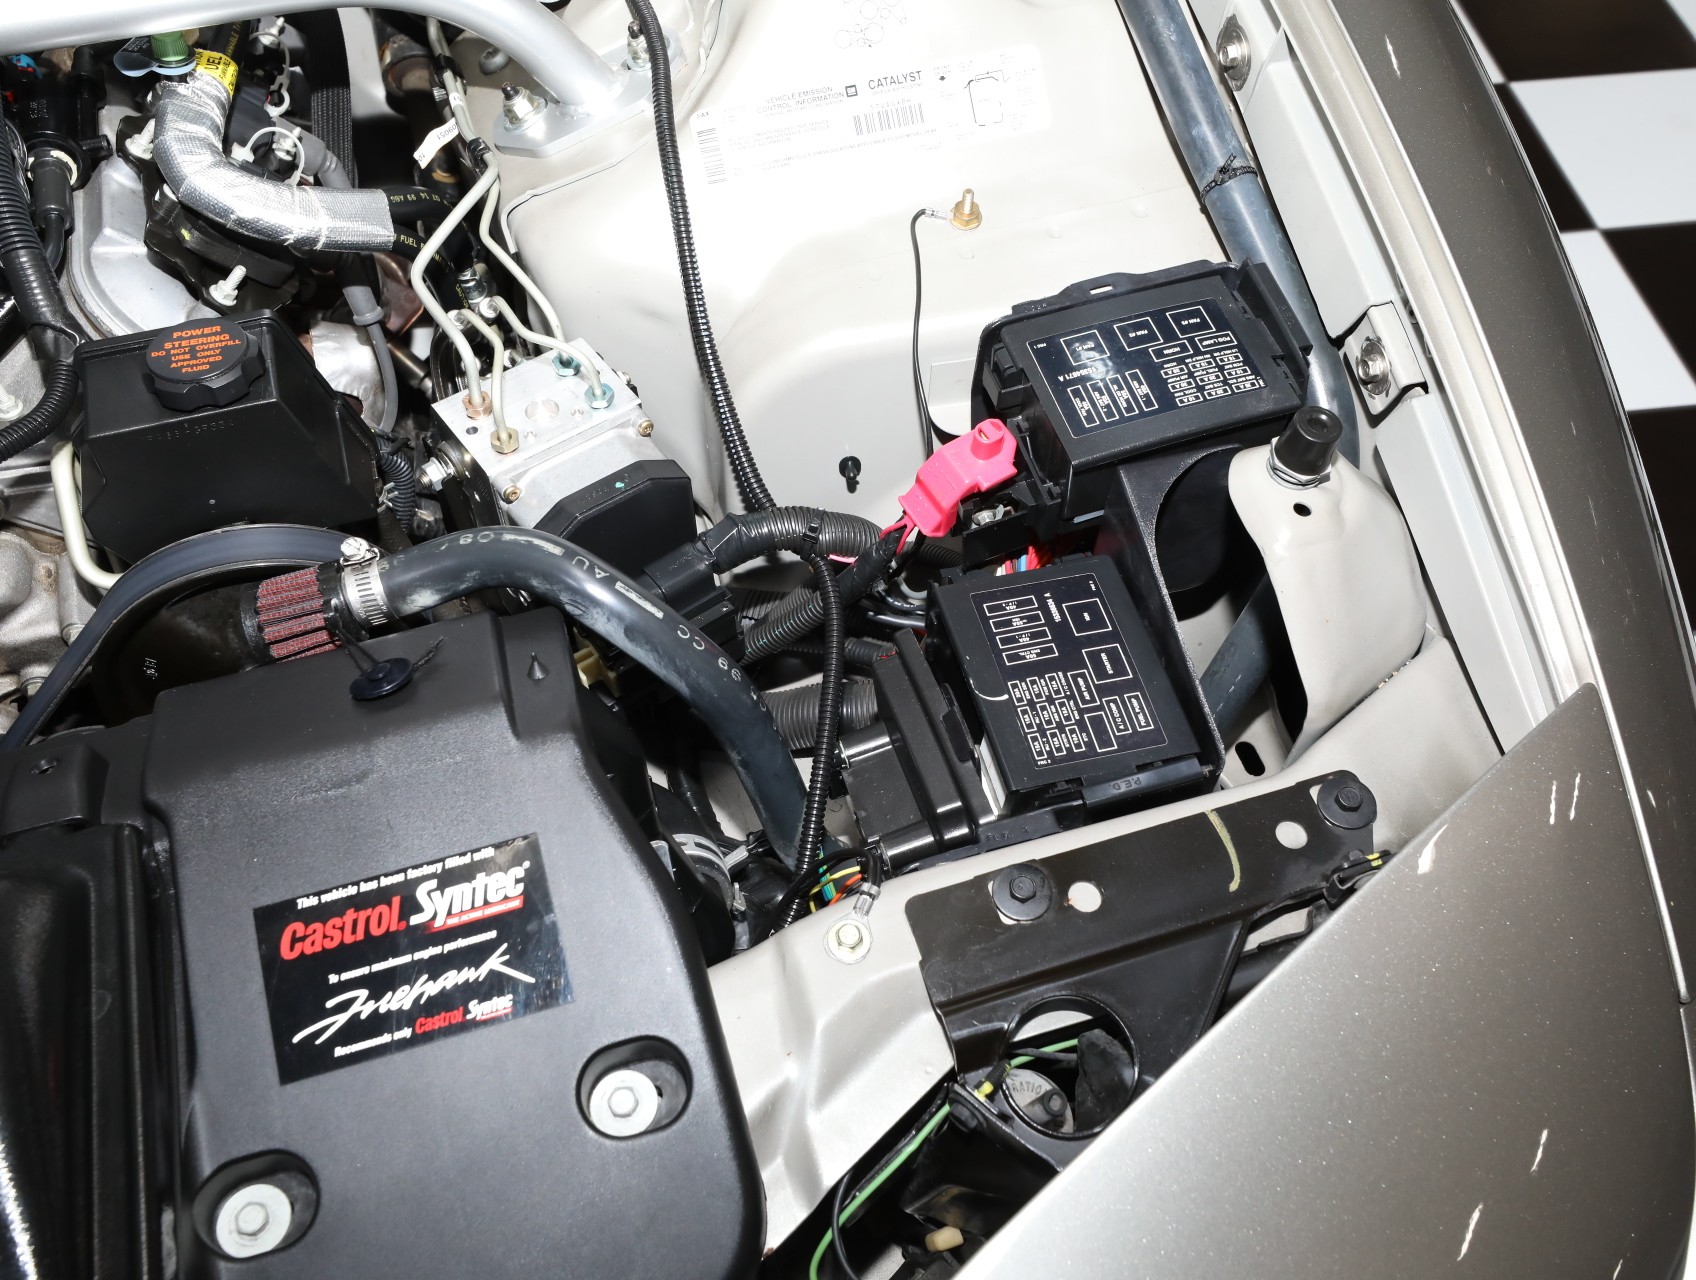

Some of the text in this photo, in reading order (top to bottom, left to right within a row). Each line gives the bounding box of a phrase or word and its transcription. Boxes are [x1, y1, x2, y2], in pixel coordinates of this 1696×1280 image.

[868, 70, 923, 91] CATALYST
[400, 234, 418, 248] FUEL
[173, 325, 221, 338] POWER
[164, 334, 230, 349] STEERING
[170, 347, 190, 355] NOT
[195, 339, 241, 351] OVERFILL
[197, 349, 221, 357] ONLY
[170, 355, 222, 368] APPROVED
[181, 364, 210, 373] FLUID
[1101, 653, 1113, 674] STARTER
[1077, 677, 1087, 691] PUMP
[1110, 703, 1119, 717] COMP
[1131, 698, 1146, 726] FUEL PUMP
[296, 846, 495, 909] This vehicle has been factory filled with
[410, 866, 525, 928] Syntec
[328, 929, 498, 985] To ensure maximum engine performance
[334, 993, 514, 1058] Recommends only Castrol Syntec
